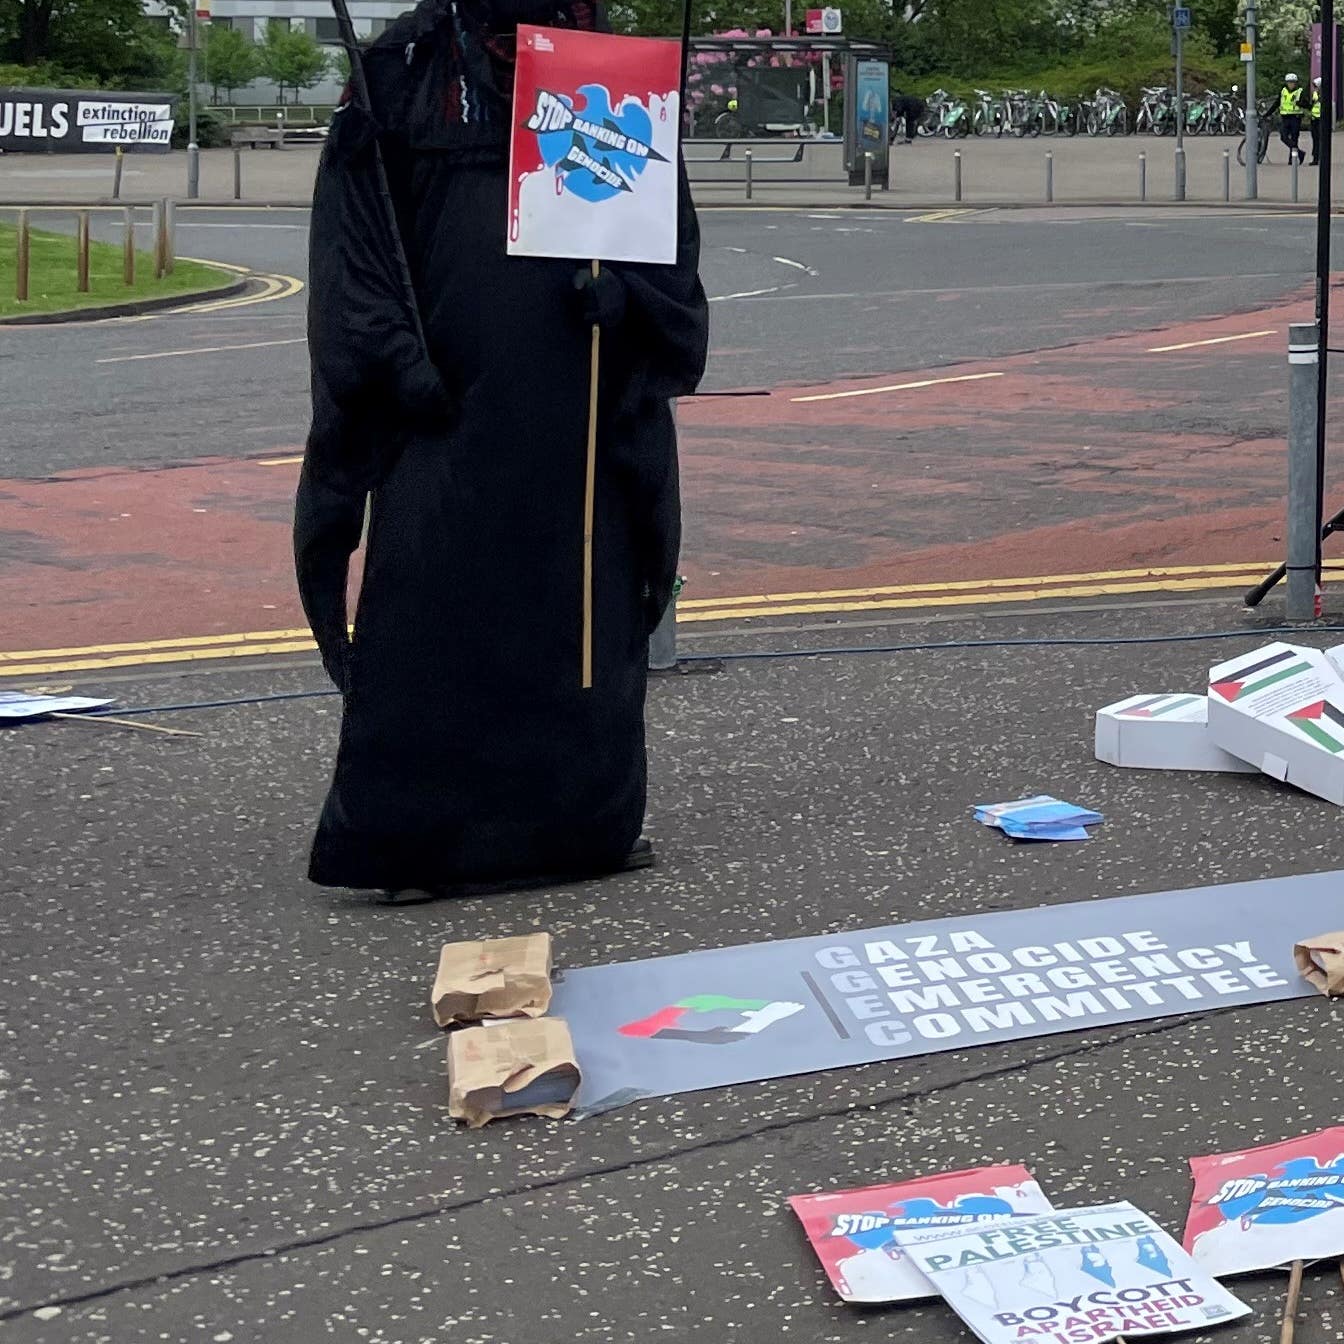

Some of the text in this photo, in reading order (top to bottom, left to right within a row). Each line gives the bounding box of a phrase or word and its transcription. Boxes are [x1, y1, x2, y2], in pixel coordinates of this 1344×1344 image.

[82, 104, 157, 122] extinction
[103, 122, 169, 141] rebellion
[528, 91, 649, 157] STOP BANKING ON
[567, 145, 624, 188] GENOCIDE
[814, 930, 996, 969] GAZA
[829, 930, 1168, 994] GENOCIDE
[845, 941, 1259, 1020] EMERGENCY
[863, 965, 1288, 1047] COMMITTEE
[1207, 1178, 1266, 1205] STOP
[1266, 1174, 1339, 1190] BANKING
[1257, 1196, 1335, 1209] GENOCIDE
[832, 1212, 889, 1237] STOP
[894, 1213, 975, 1226] BANKING
[978, 1218, 1082, 1248] FREE
[924, 1219, 1155, 1274] PALESTINE
[993, 1278, 1196, 1327] BOYCOTT
[1016, 1294, 1205, 1338] APARTHEID
[1053, 1312, 1192, 1344] ISRAEL
